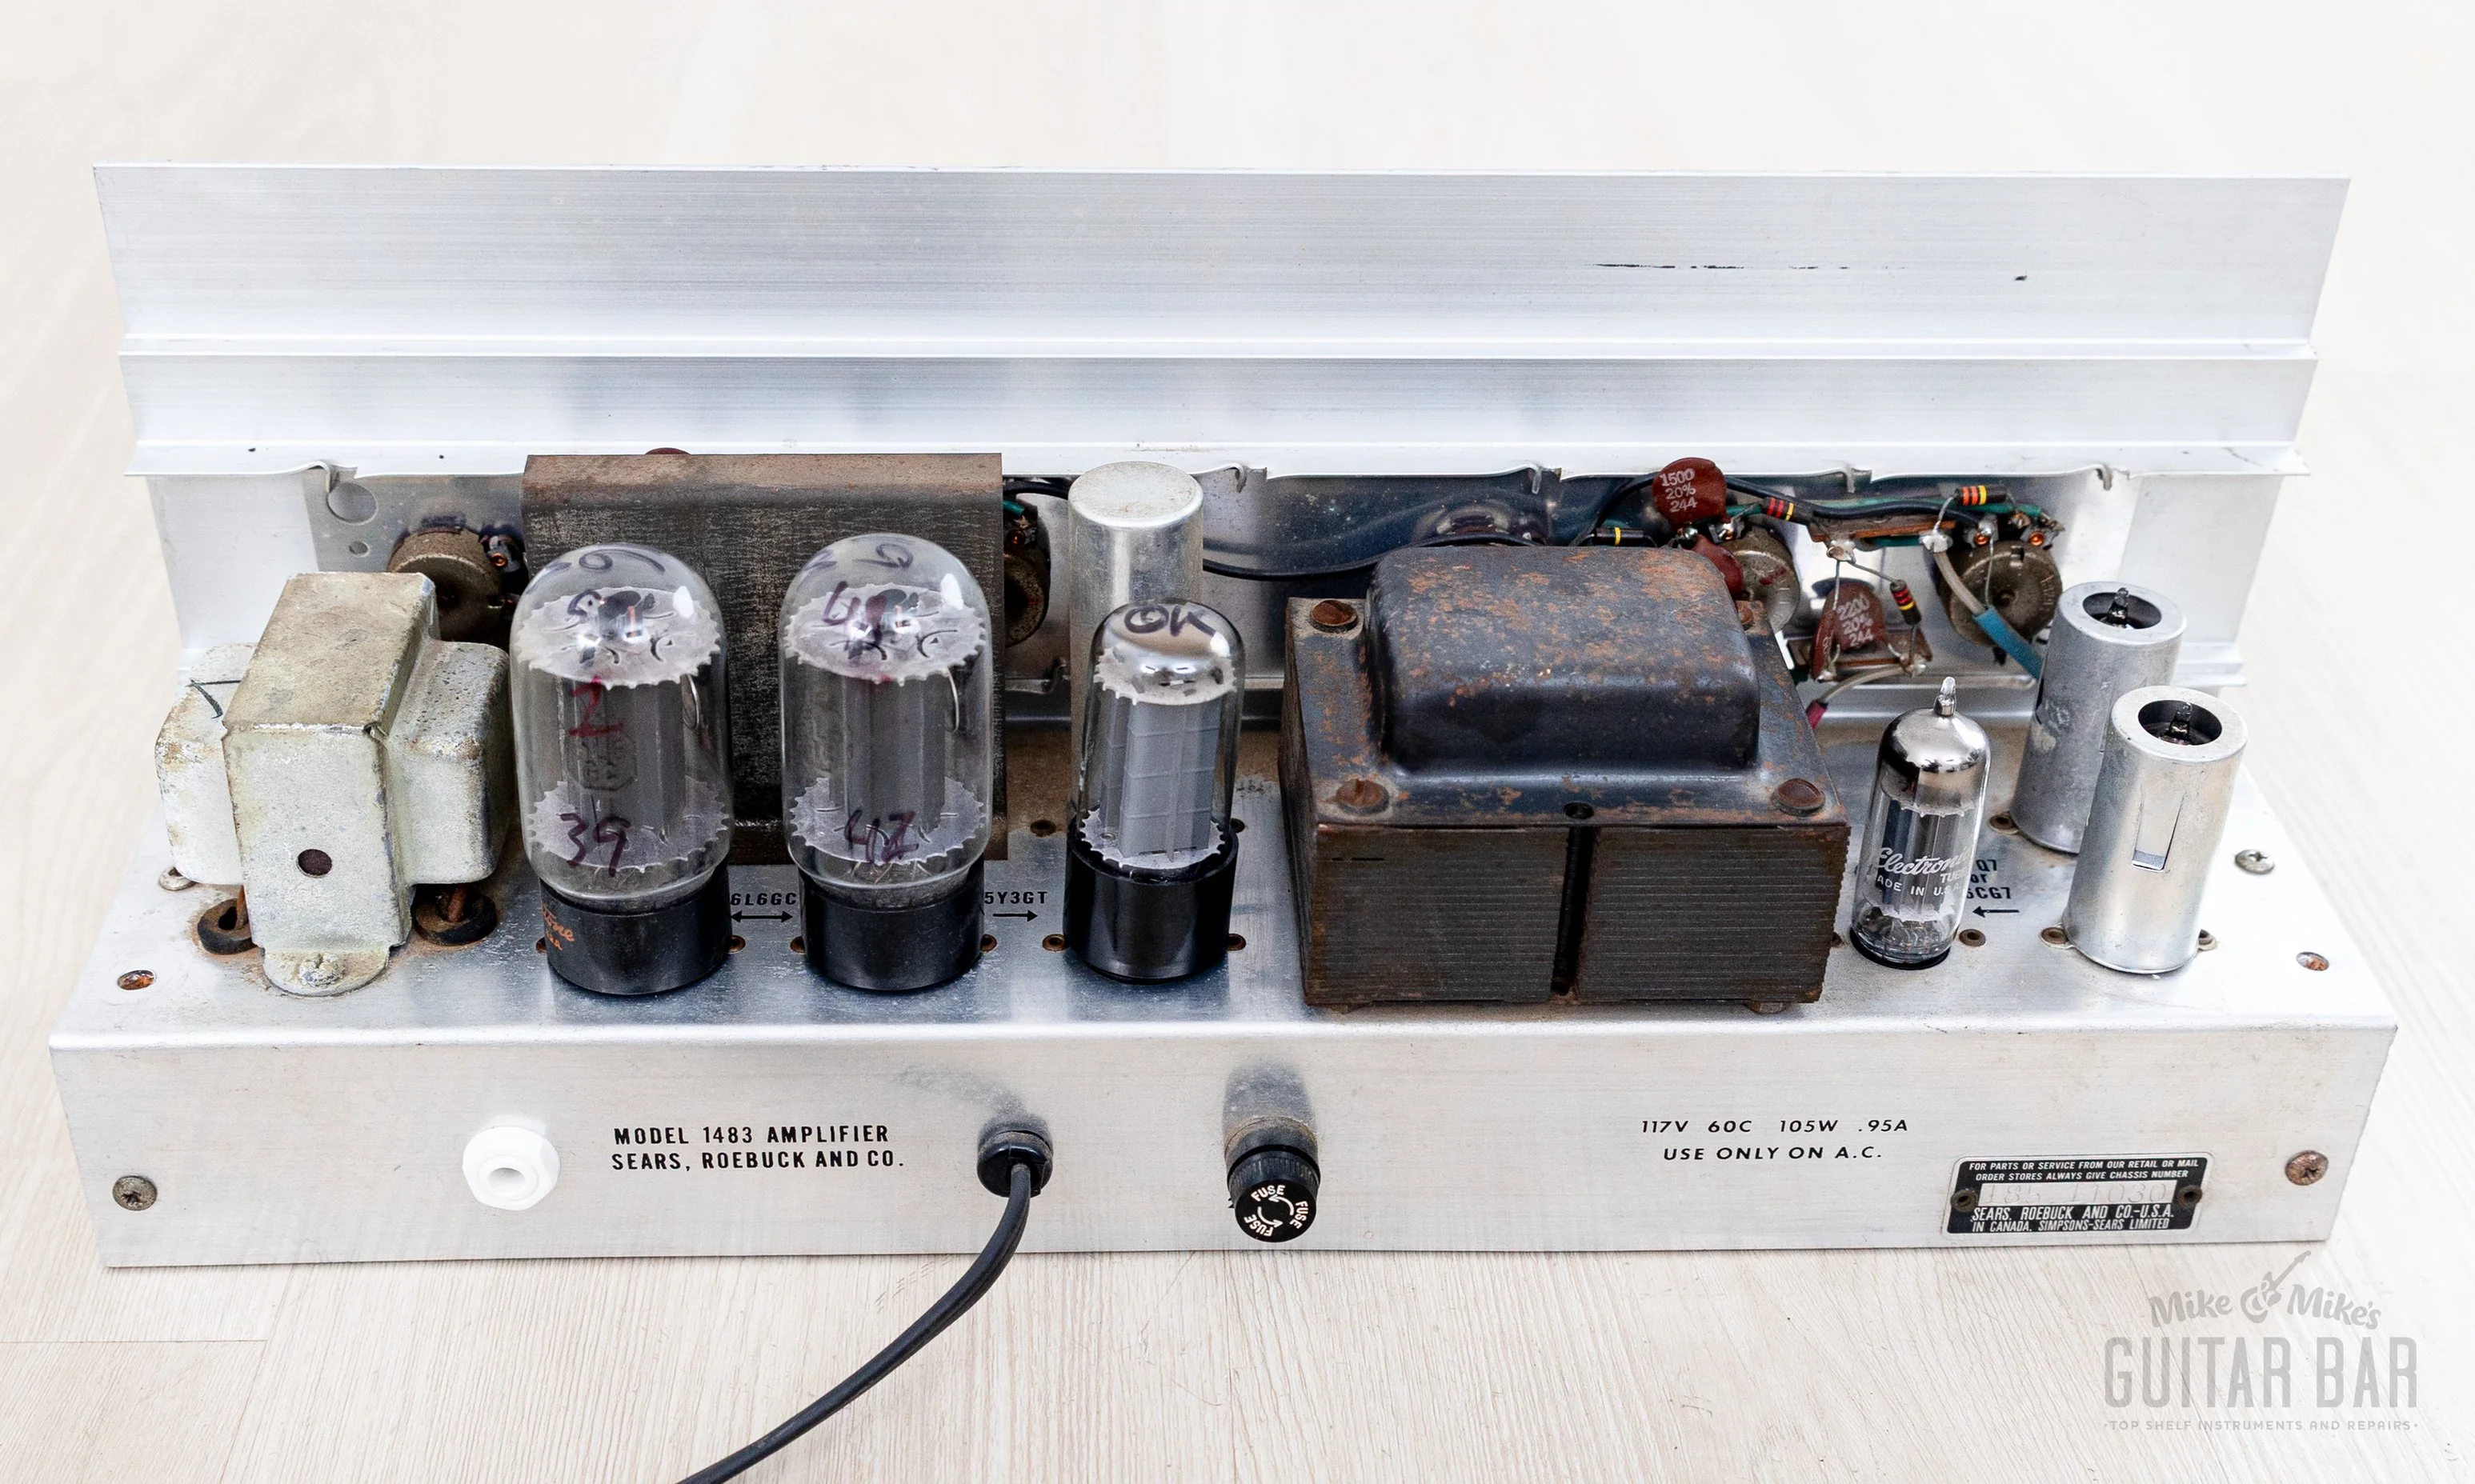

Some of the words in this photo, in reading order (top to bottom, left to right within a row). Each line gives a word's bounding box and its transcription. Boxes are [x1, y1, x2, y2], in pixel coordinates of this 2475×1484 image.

[1660, 468, 1696, 486] 1500
[1665, 482, 1696, 500] 20%
[1670, 497, 1697, 513] 244
[1836, 592, 1869, 621] 2200
[1123, 605, 1217, 638] OK
[1849, 628, 1873, 646] 244
[559, 813, 631, 877] 39
[1876, 874, 1903, 892] ADE
[1910, 886, 1925, 896] IN
[1970, 874, 1988, 884] or
[730, 892, 797, 907] 6L6GC
[983, 890, 1047, 906] 5Y3GT
[614, 1126, 690, 1145] MODEL
[703, 1126, 753, 1143] 1483
[767, 1125, 889, 1143] AMPLIFIER
[1642, 1120, 1689, 1133] 117V
[1708, 1120, 1752, 1133] 60C
[1780, 1120, 1839, 1133] 105W
[1858, 1119, 1908, 1132] .95A
[612, 1152, 691, 1171] SEARS,
[703, 1151, 806, 1168] ROEBUCK
[815, 1150, 859, 1167] AND
[867, 1150, 905, 1167] CO.
[1664, 1147, 1705, 1161] USE
[1716, 1146, 1780, 1160] ONLY
[1788, 1146, 1824, 1159] ON
[1835, 1146, 1883, 1159] A.C.
[1969, 1162, 1987, 1170] FOR
[1990, 1162, 2019, 1170] PARTS
[2022, 1162, 2035, 1170] OR
[2038, 1161, 2076, 1170] SERVICE
[2078, 1161, 2104, 1169] FROM
[2106, 1160, 2125, 1169] OUR
[2128, 1160, 2158, 1168] RETAIL
[2162, 1159, 2175, 1168] OR
[2177, 1159, 2199, 1167] MAIL
[1976, 1173, 2004, 1181] ORDER
[2008, 1173, 2043, 1181] STORES
[2046, 1172, 2082, 1180] ALWAYS
[2085, 1171, 2107, 1180] GIVE
[2109, 1170, 2149, 1178] CHASSIS
[2151, 1170, 2189, 1178] NUMBER
[1250, 1184, 1287, 1202] FUSE
[1289, 1200, 1309, 1230] FUSE
[2020, 1206, 2074, 1221] ROEBUCK
[2081, 1205, 2109, 1219] AND
[1244, 1213, 1275, 1237] FUSE
[1972, 1221, 1984, 1233] IN
[2037, 1218, 2125, 1232] SIMPSONS-SEARS
[2129, 1218, 2170, 1230] LIMITED
